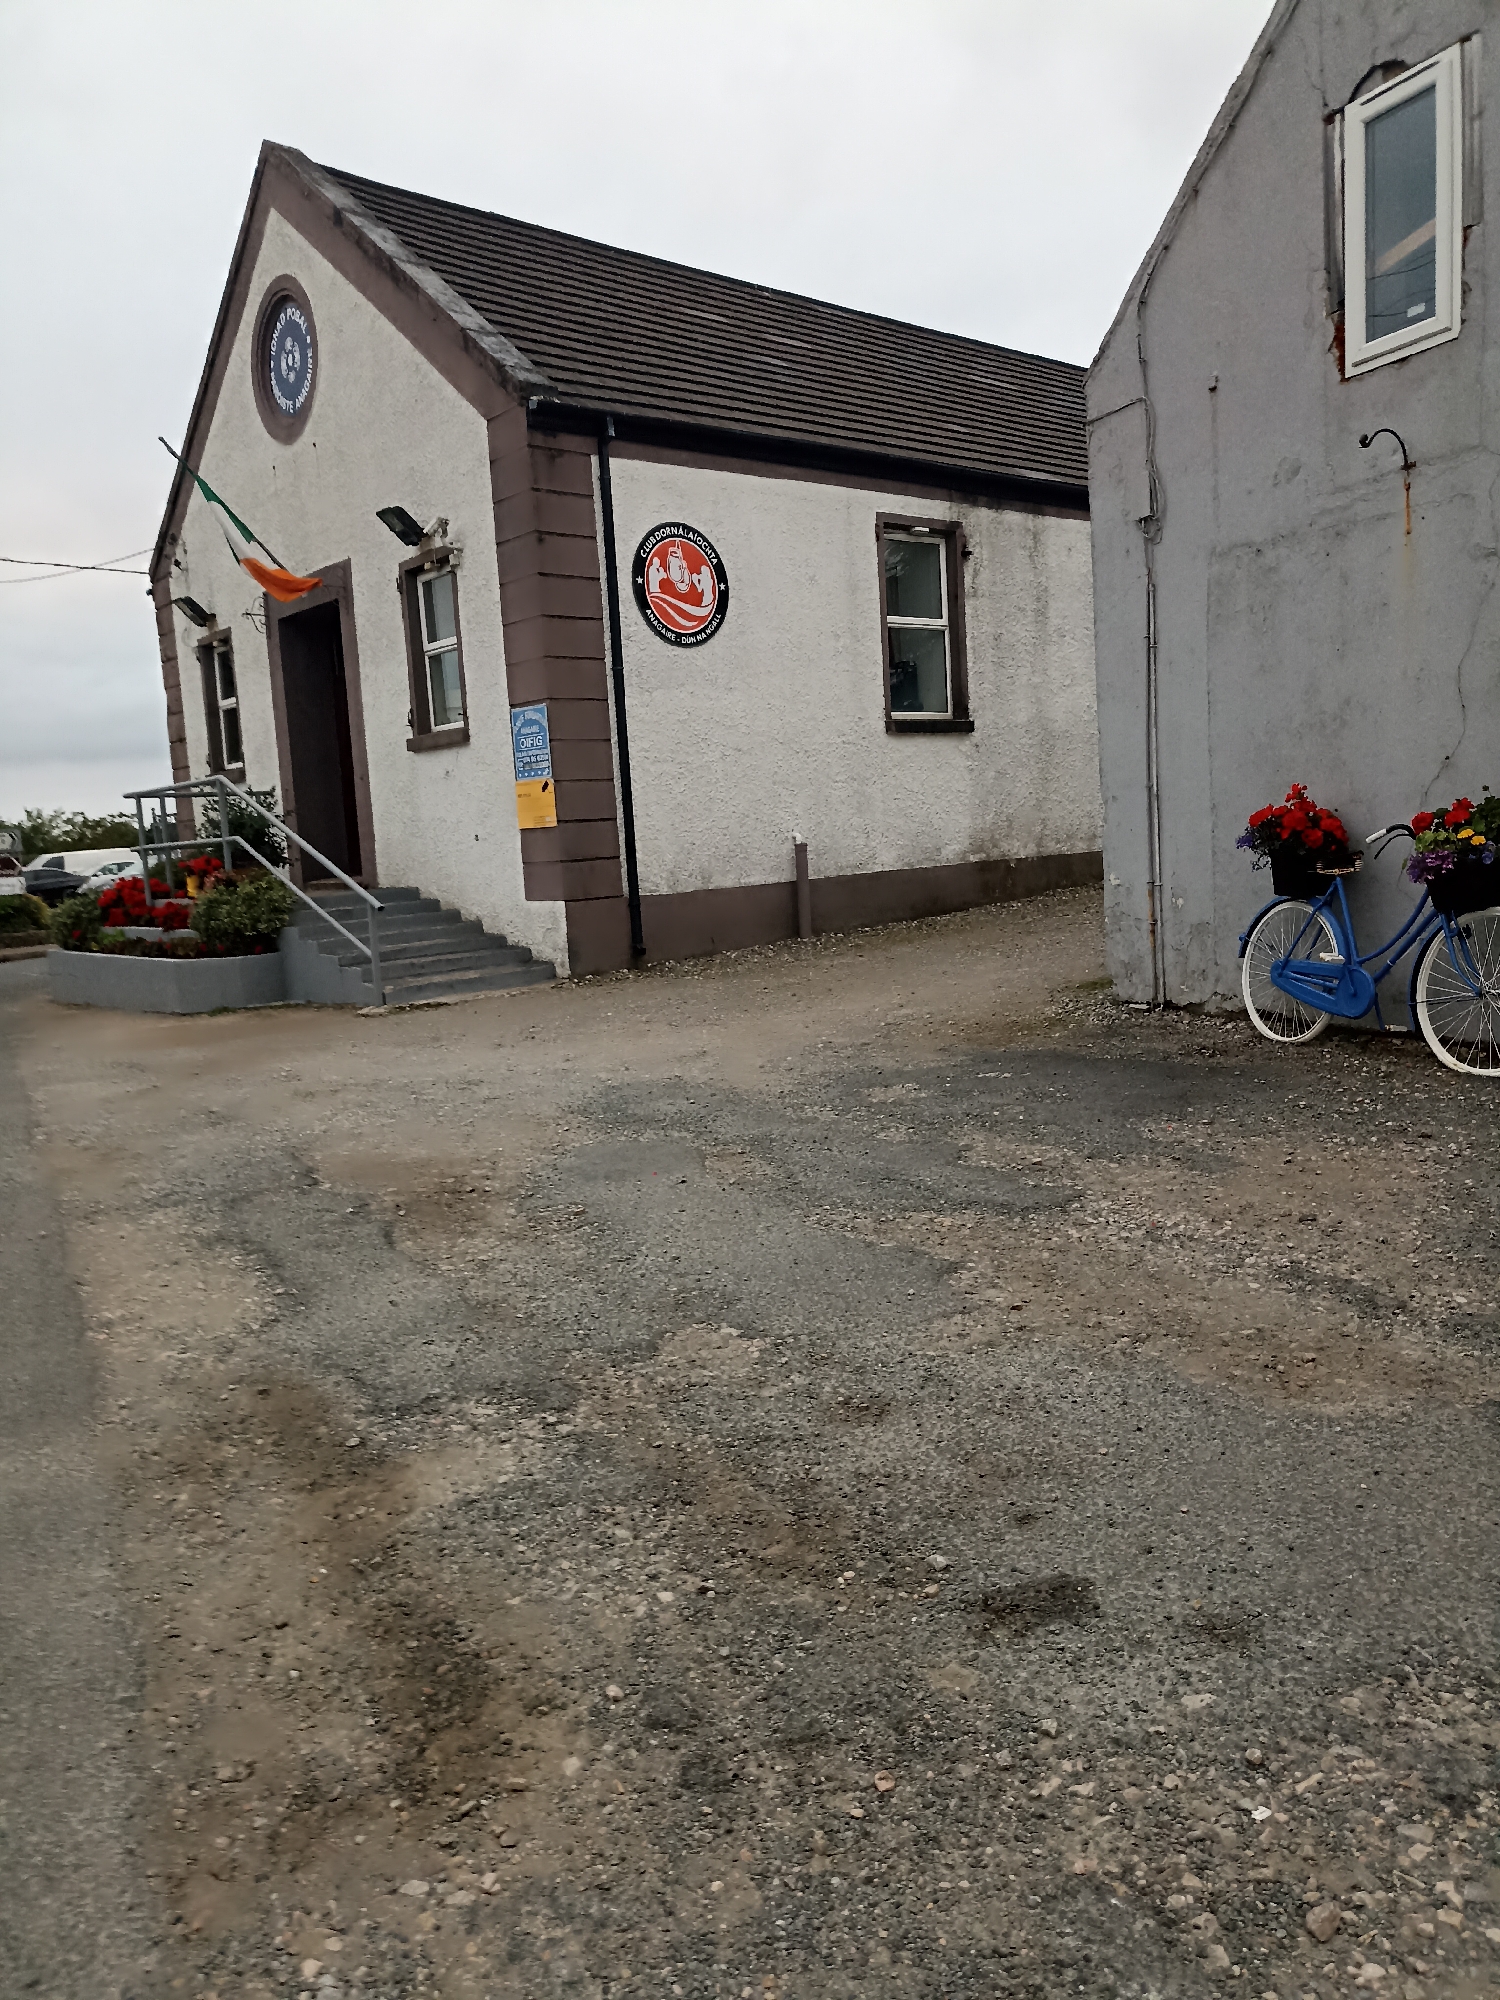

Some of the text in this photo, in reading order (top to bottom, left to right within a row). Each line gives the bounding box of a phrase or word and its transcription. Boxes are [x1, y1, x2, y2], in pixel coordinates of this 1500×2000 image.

[271, 313, 285, 355] IONAD
[645, 609, 676, 641] ANAGAIRE
[696, 632, 707, 641] NA
[705, 614, 721, 636] NGALL
[520, 735, 543, 749] OIFIG
